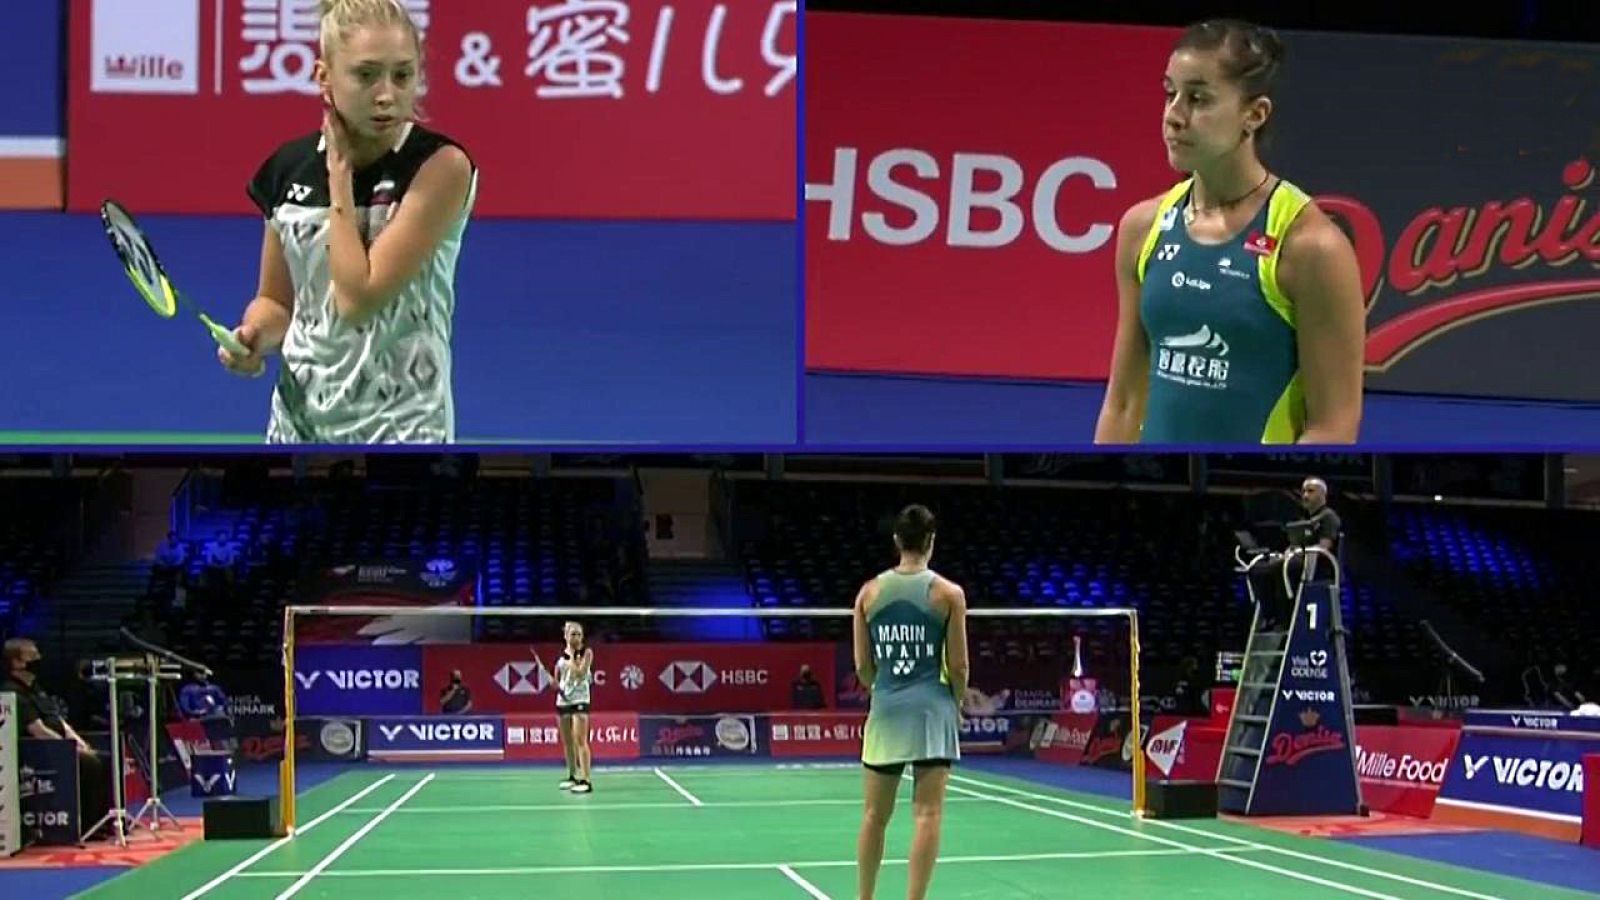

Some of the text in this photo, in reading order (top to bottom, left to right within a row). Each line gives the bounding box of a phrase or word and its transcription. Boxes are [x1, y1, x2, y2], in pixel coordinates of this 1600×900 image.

[454, 32, 502, 87] &
[805, 147, 1114, 253] HSBC
[1306, 603, 1318, 630] 1
[878, 624, 926, 643] MARIN
[325, 669, 420, 689] VICTOR
[721, 670, 768, 685] HSBC
[1295, 689, 1335, 702] VICTOR
[409, 723, 495, 741] VICTOR
[959, 717, 1010, 733] CTOR
[1523, 715, 1559, 730] VICTOR
[1358, 754, 1450, 783] Mille Food
[1493, 755, 1583, 793] VICTOR
[22, 810, 70, 826] CTOR
